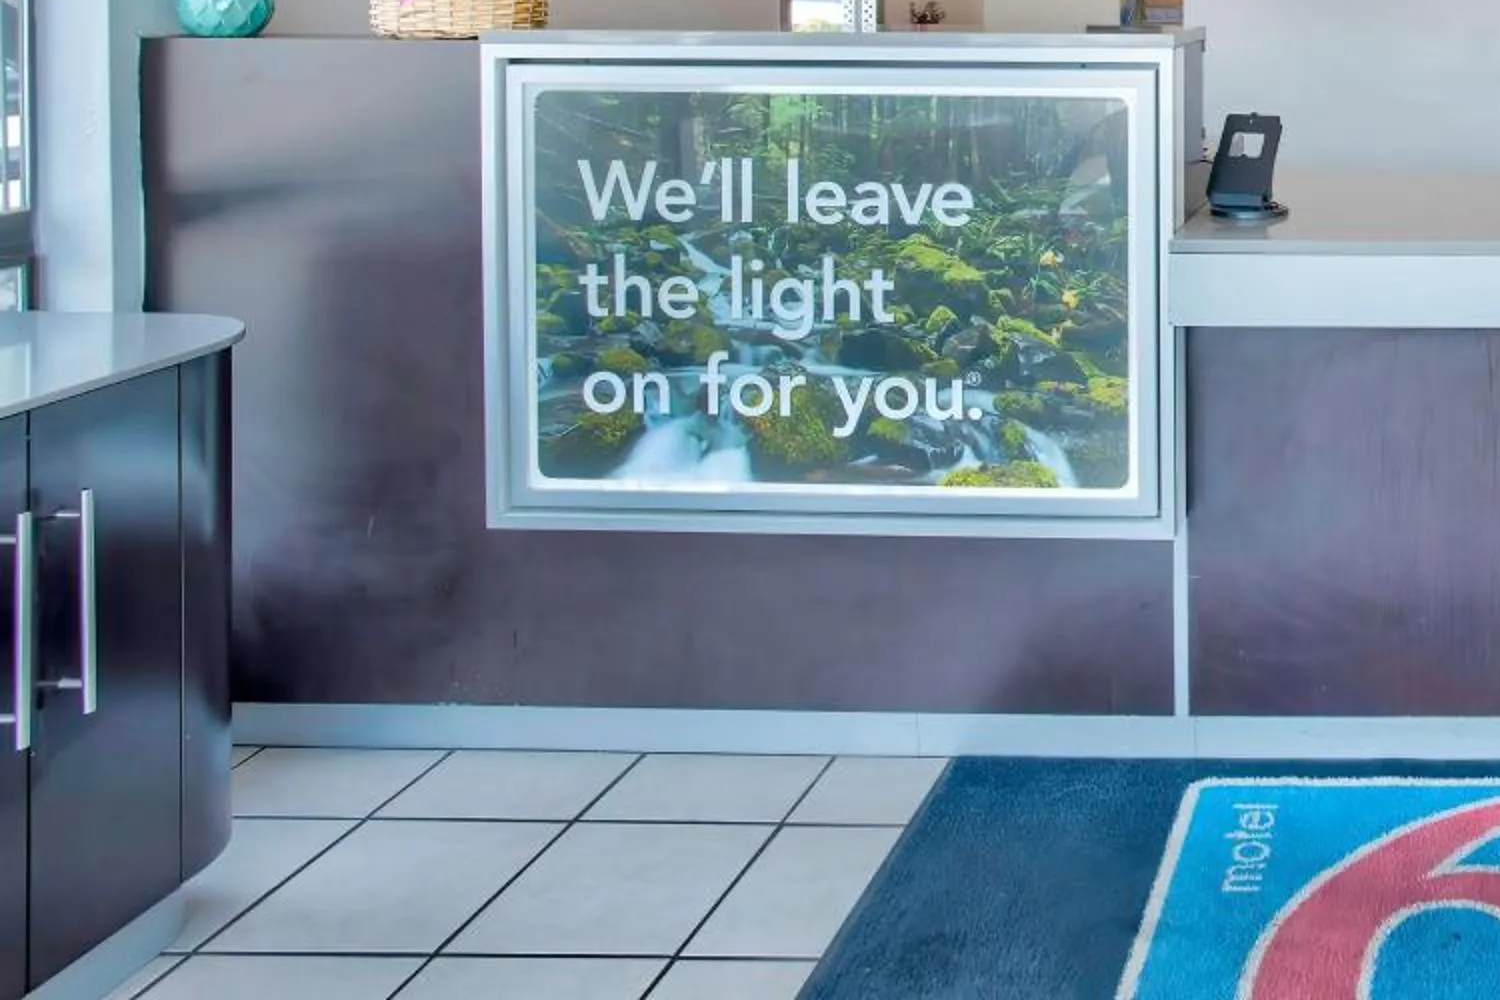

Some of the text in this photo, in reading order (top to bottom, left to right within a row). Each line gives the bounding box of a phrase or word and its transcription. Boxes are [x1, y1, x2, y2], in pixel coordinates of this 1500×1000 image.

[577, 157, 975, 228] We'll leave
[578, 253, 896, 342] the light
[582, 368, 671, 416] on
[699, 350, 808, 418] for
[1221, 803, 1279, 893] motel
